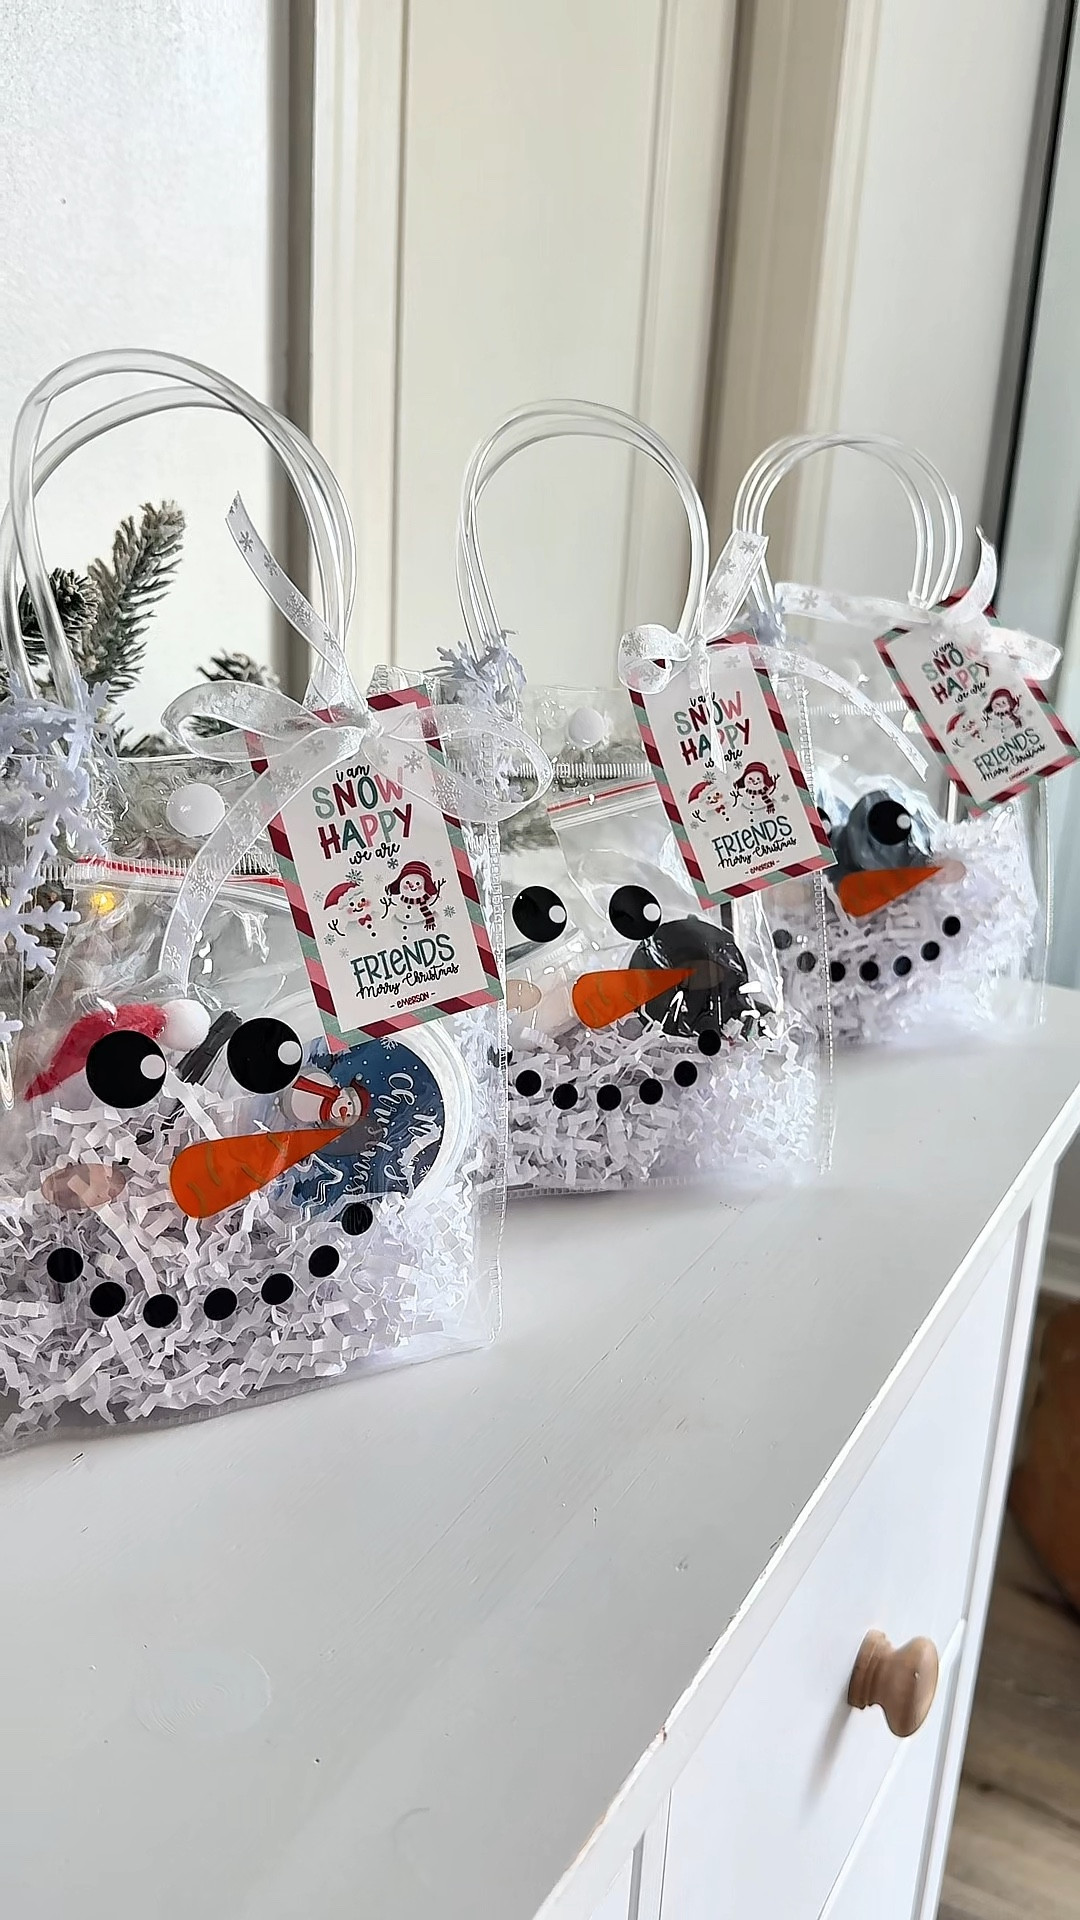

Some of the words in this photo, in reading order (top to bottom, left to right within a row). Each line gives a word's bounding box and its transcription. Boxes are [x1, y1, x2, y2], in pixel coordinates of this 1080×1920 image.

[673, 690, 742, 735] SNOW
[335, 769, 344, 783] i
[346, 764, 371, 779] am
[723, 749, 743, 762] are
[312, 766, 404, 820] SNOW
[317, 803, 413, 860] HAPPY
[752, 837, 797, 858] Christmas
[348, 850, 373, 865] we
[375, 842, 401, 859] are
[355, 982, 401, 1000] Merry
[402, 962, 460, 987] Christmas
[342, 1072, 416, 1195] Christmas
